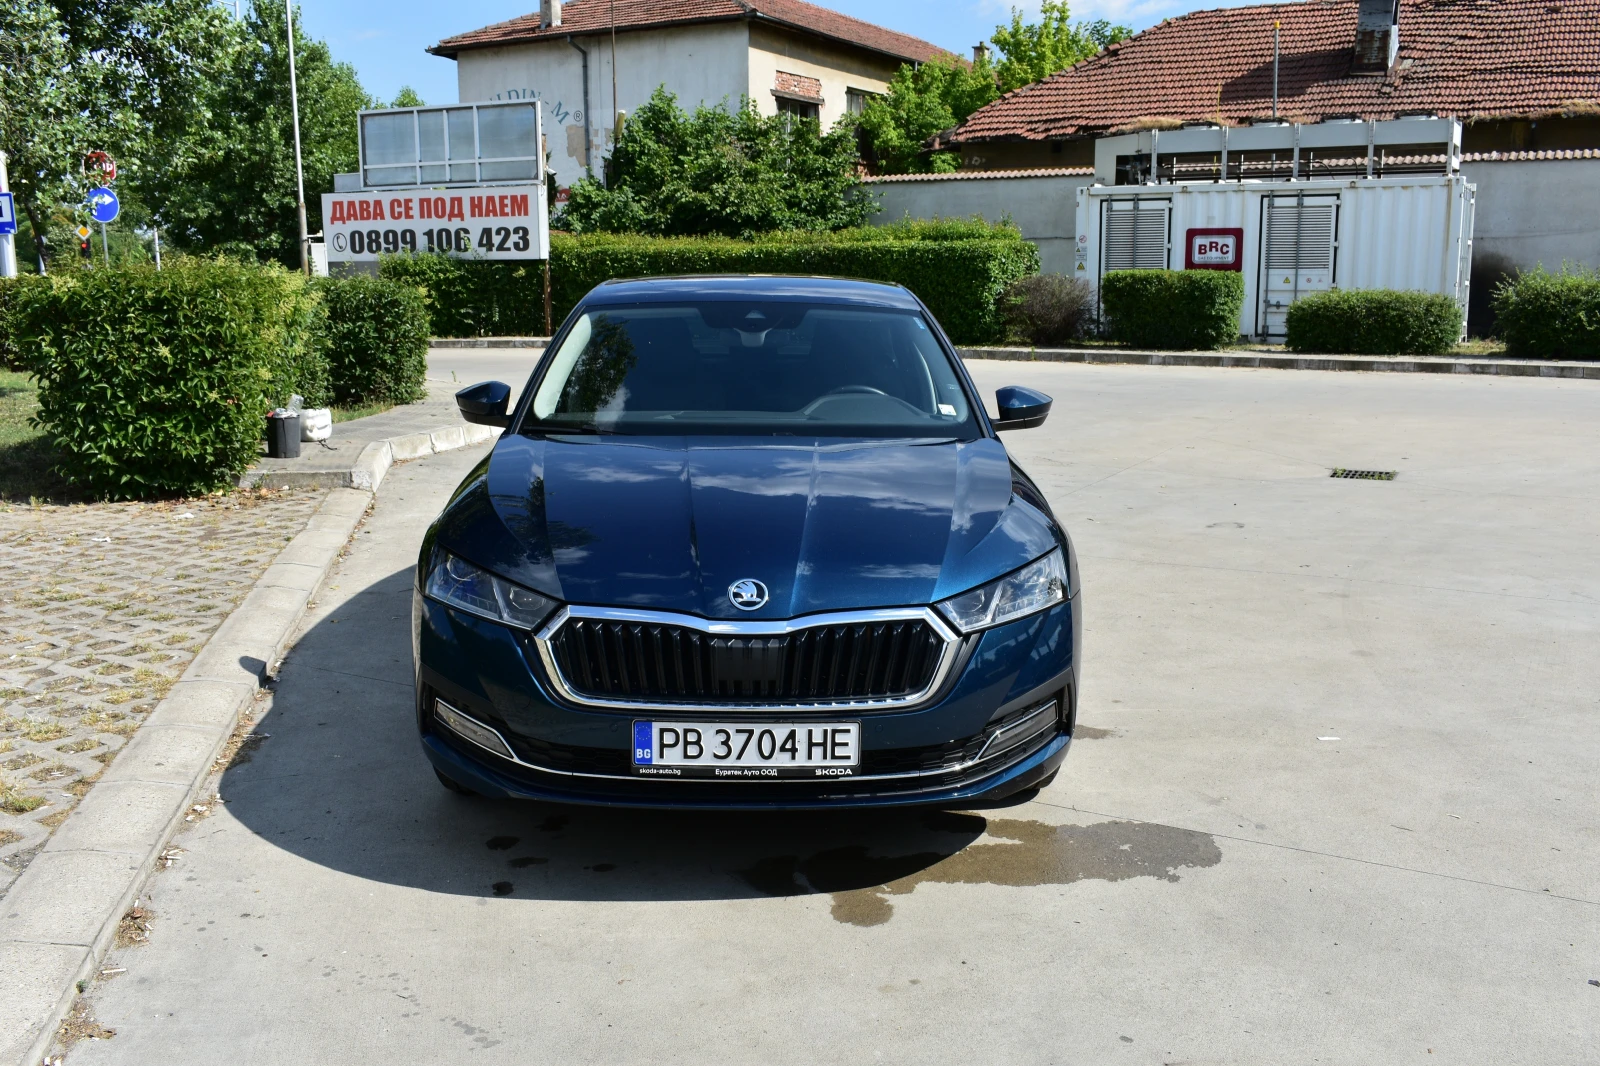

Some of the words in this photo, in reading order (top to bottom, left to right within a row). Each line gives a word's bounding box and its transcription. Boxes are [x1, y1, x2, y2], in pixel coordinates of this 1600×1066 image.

[330, 200, 385, 225] ДАВА
[389, 198, 414, 221] СЕ
[418, 196, 465, 222] ПОД
[469, 194, 529, 218] НАЕМ
[350, 228, 417, 254] 0899
[423, 227, 471, 253] 106
[477, 226, 530, 252] 423
[1198, 241, 1230, 255] BRC
[659, 727, 705, 759] PB
[713, 728, 799, 760] 3704
[807, 728, 852, 760] HE
[636, 749, 651, 759] BG
[639, 767, 681, 776] skoda-auto.bg
[715, 768, 742, 776] Еуратек
[743, 768, 760, 776] Ауто
[761, 768, 778, 776] ООД
